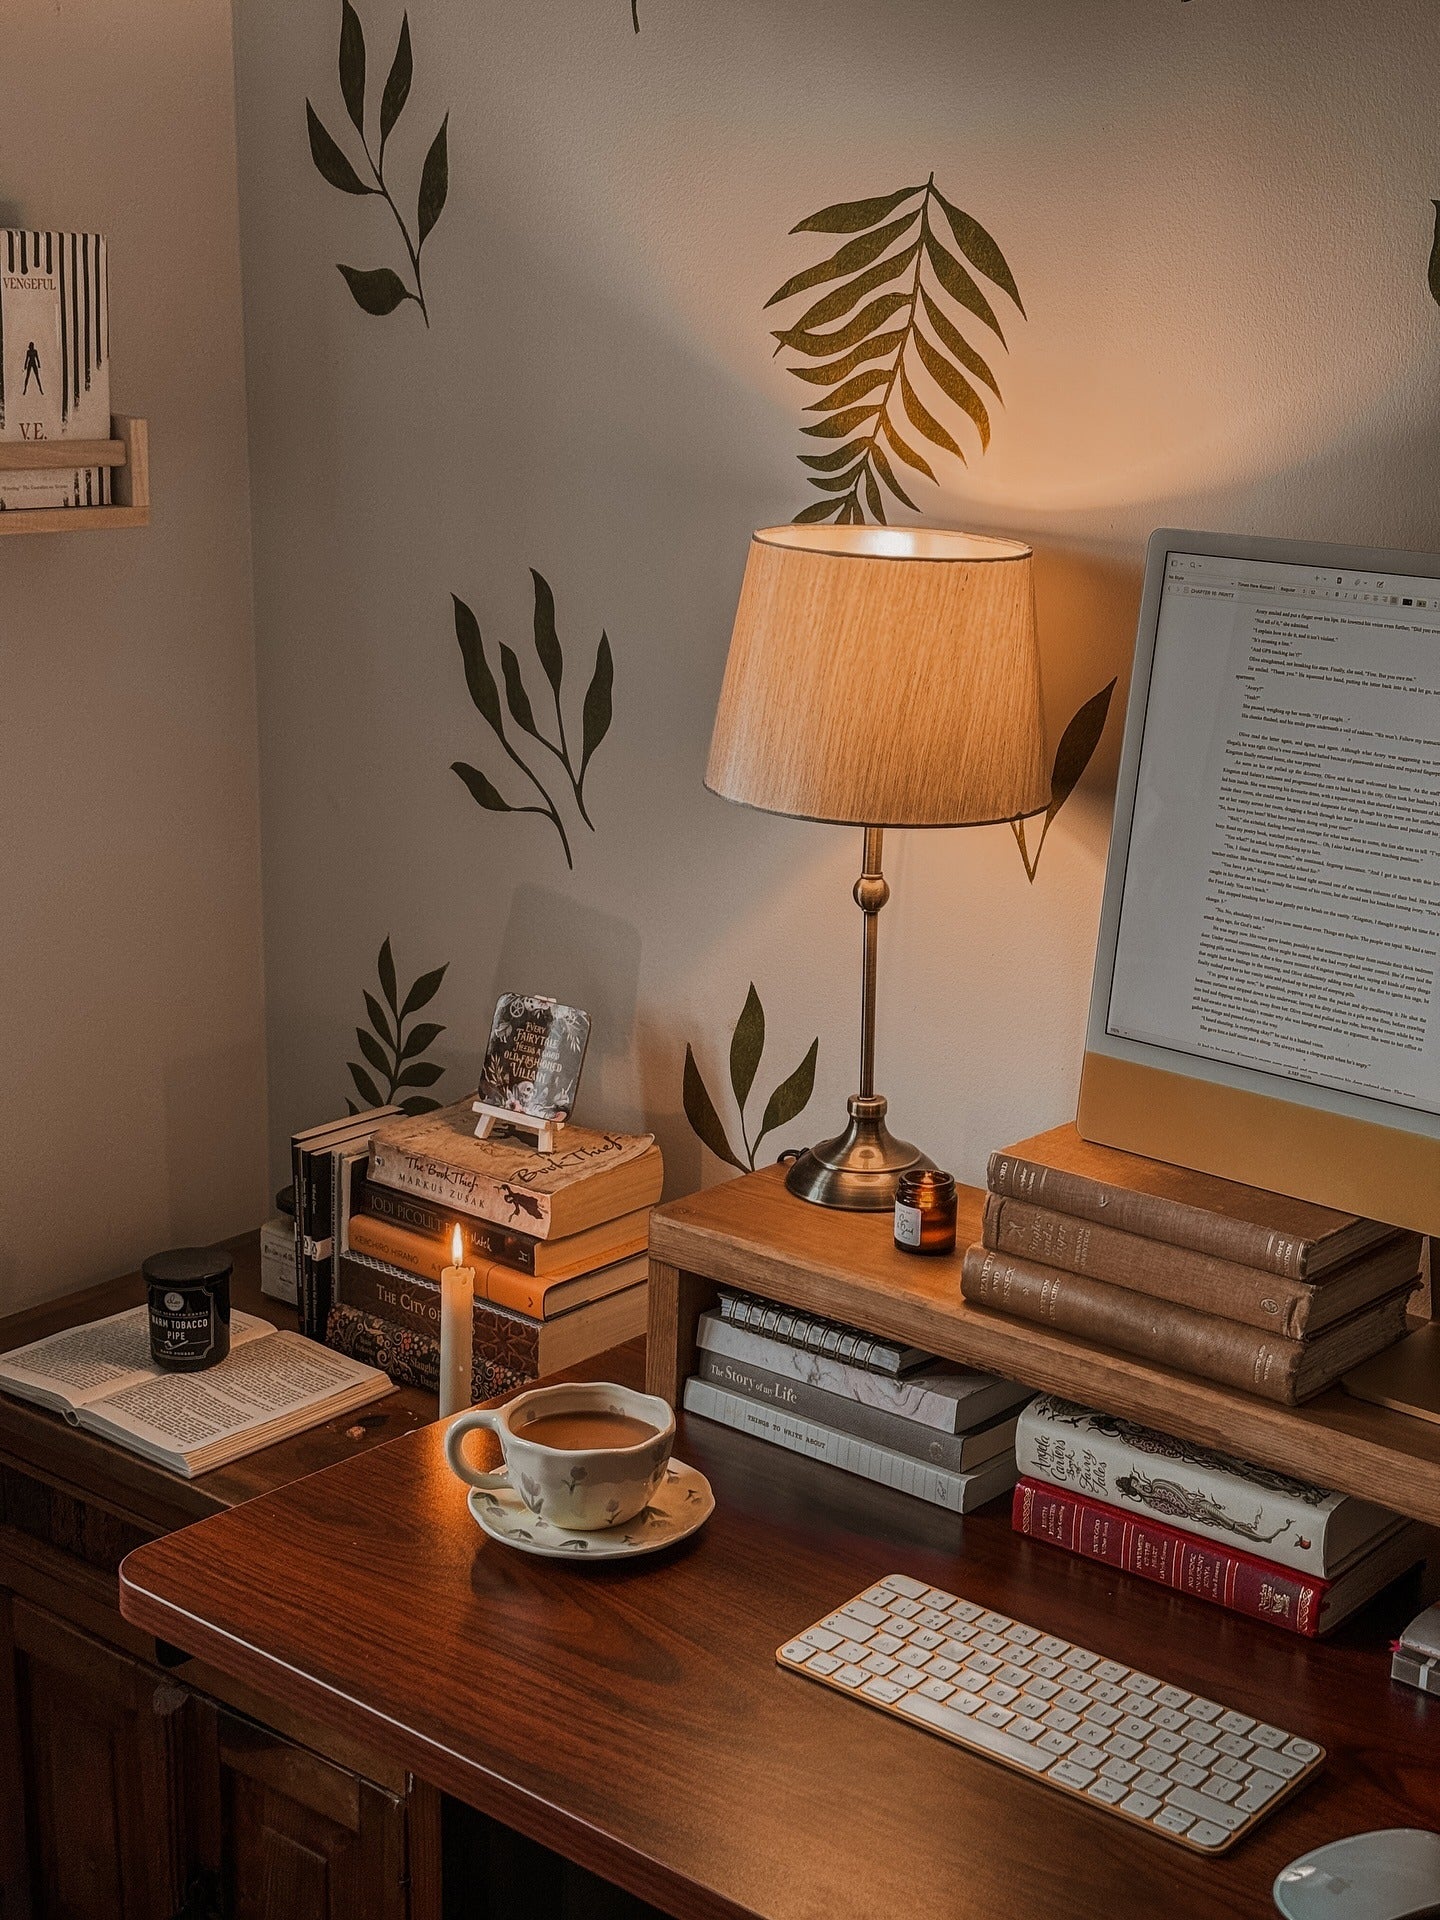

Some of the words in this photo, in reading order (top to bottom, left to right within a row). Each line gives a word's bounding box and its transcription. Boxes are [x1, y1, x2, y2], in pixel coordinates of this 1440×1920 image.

[2, 277, 57, 291] VENGEFUL
[513, 1028, 560, 1049] FAIRYTALE
[525, 1022, 546, 1033] EVERY
[510, 1061, 546, 1083] VILLAIN
[405, 1156, 425, 1172] The
[427, 1163, 453, 1181] Book
[450, 1171, 478, 1192] Thief
[508, 1160, 566, 1183] Book
[565, 1134, 623, 1162] Thief
[398, 1173, 444, 1194] MARKUS
[450, 1189, 486, 1209] ZUSAK
[371, 1195, 394, 1214] JODI
[397, 1204, 442, 1232] PICOULT
[391, 1248, 419, 1265] HIRANO
[1052, 1225, 1067, 1258] Tiger
[992, 1271, 1000, 1290] AND
[376, 1283, 396, 1305] THE
[400, 1293, 426, 1316] CITY
[152, 1315, 168, 1327] WARM
[171, 1319, 208, 1329] TOBACCO
[168, 1331, 185, 1340] PIPE
[710, 1363, 725, 1379] The
[725, 1365, 755, 1390] Story
[755, 1381, 763, 1392] of
[763, 1385, 774, 1398] my
[774, 1382, 798, 1405] Life
[746, 1413, 771, 1428] THINGS
[772, 1423, 781, 1432] TO
[783, 1427, 804, 1442] WRITE
[805, 1436, 827, 1451] ABOUT
[1031, 1435, 1054, 1476] Angela
[1051, 1439, 1067, 1481] Carter's
[1065, 1450, 1075, 1480] Book
[1079, 1449, 1096, 1492] Fairy
[1092, 1462, 1108, 1496] Tales
[1196, 1553, 1205, 1580] MOUNT
